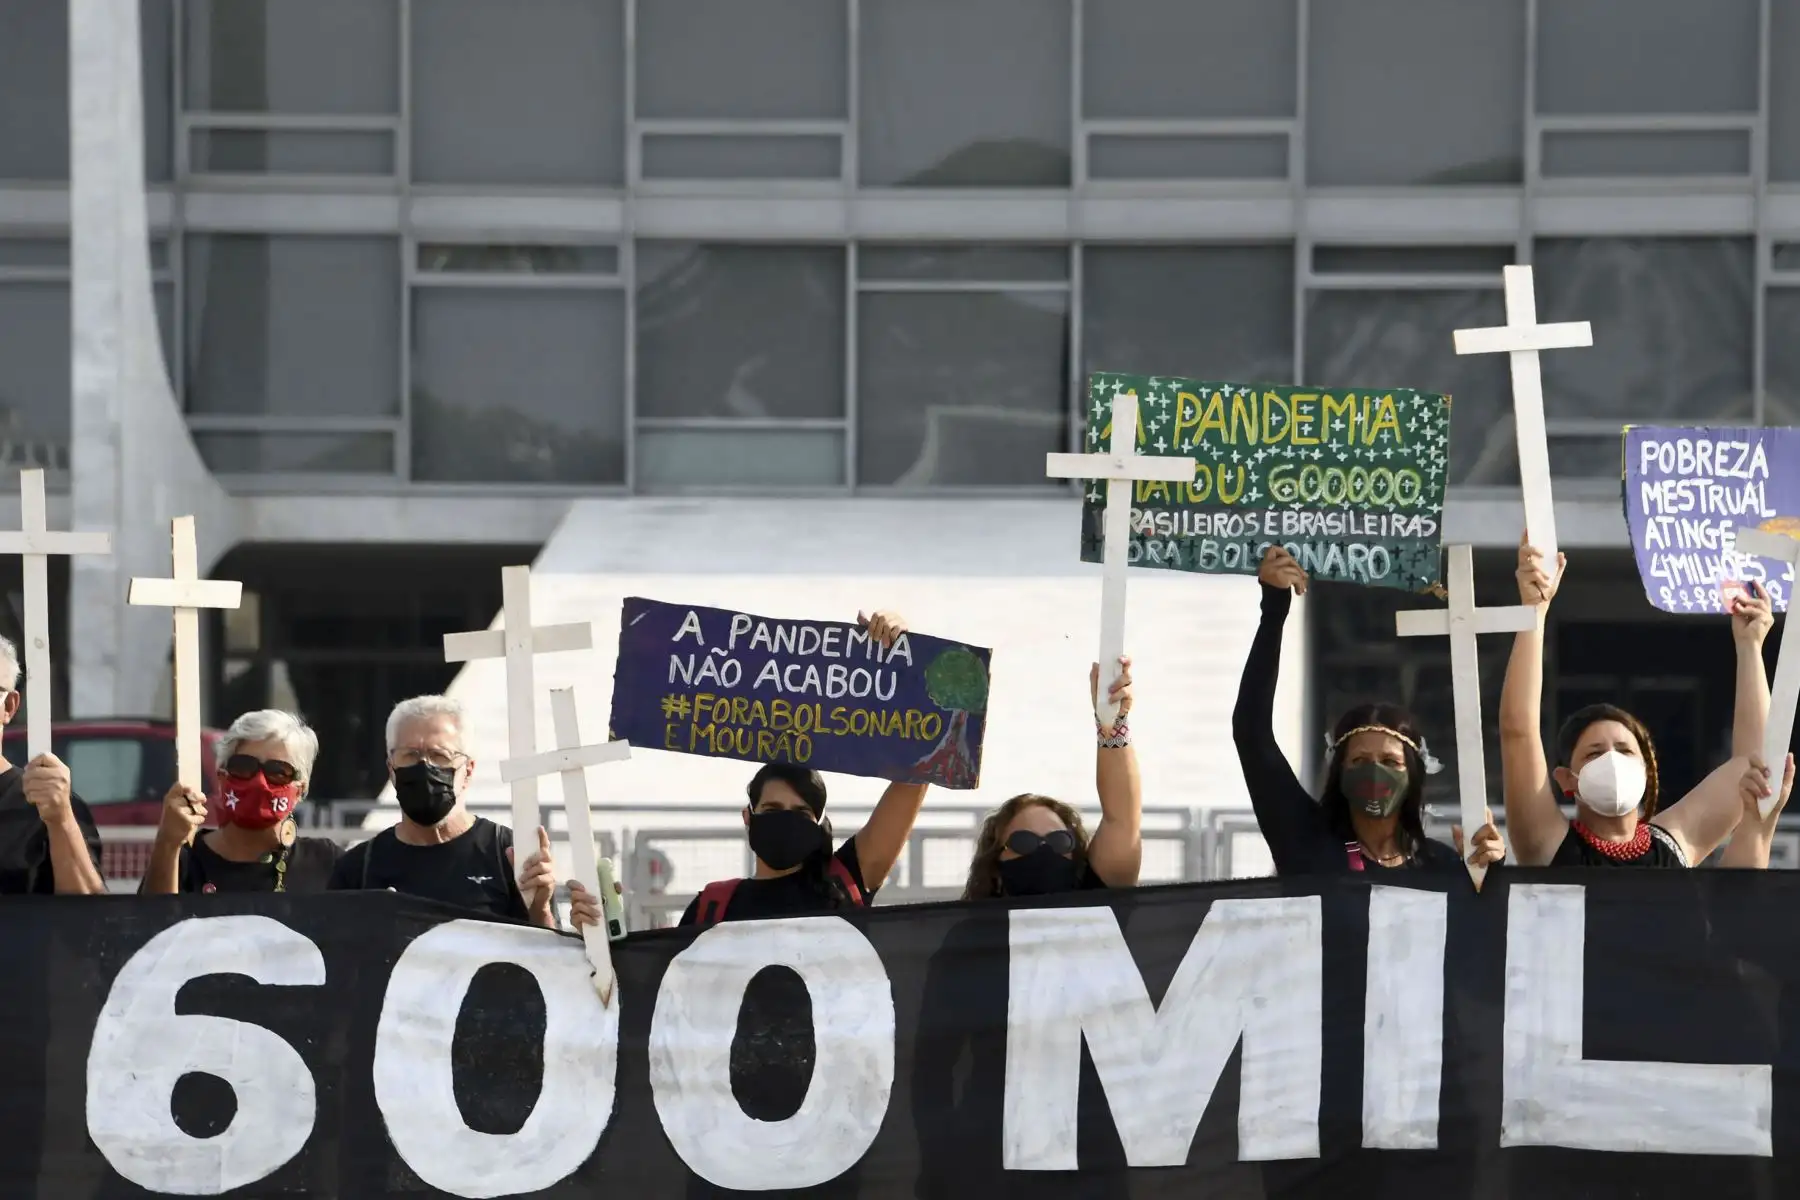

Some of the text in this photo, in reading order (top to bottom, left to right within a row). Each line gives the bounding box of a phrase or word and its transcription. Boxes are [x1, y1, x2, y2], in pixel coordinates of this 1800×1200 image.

[1173, 391, 1401, 449] PANDEMIA
[1641, 438, 1769, 479] POBREZA
[1269, 463, 1421, 506] 600000
[1641, 478, 1777, 518] MESTRUAL
[1102, 508, 1260, 539] RASILEIROS
[1282, 509, 1437, 538] BRASILEIRAS
[1645, 516, 1736, 551] ATINGE
[1103, 540, 1181, 565] ORA
[672, 610, 913, 667] A PANDEMIA
[668, 647, 897, 700] NÃO ACABOU
[660, 692, 942, 742] #FORABOLSONARO
[664, 722, 812, 763] E MOURÃO
[271, 797, 289, 812] 13
[86, 883, 1773, 1199] 600 MIL
